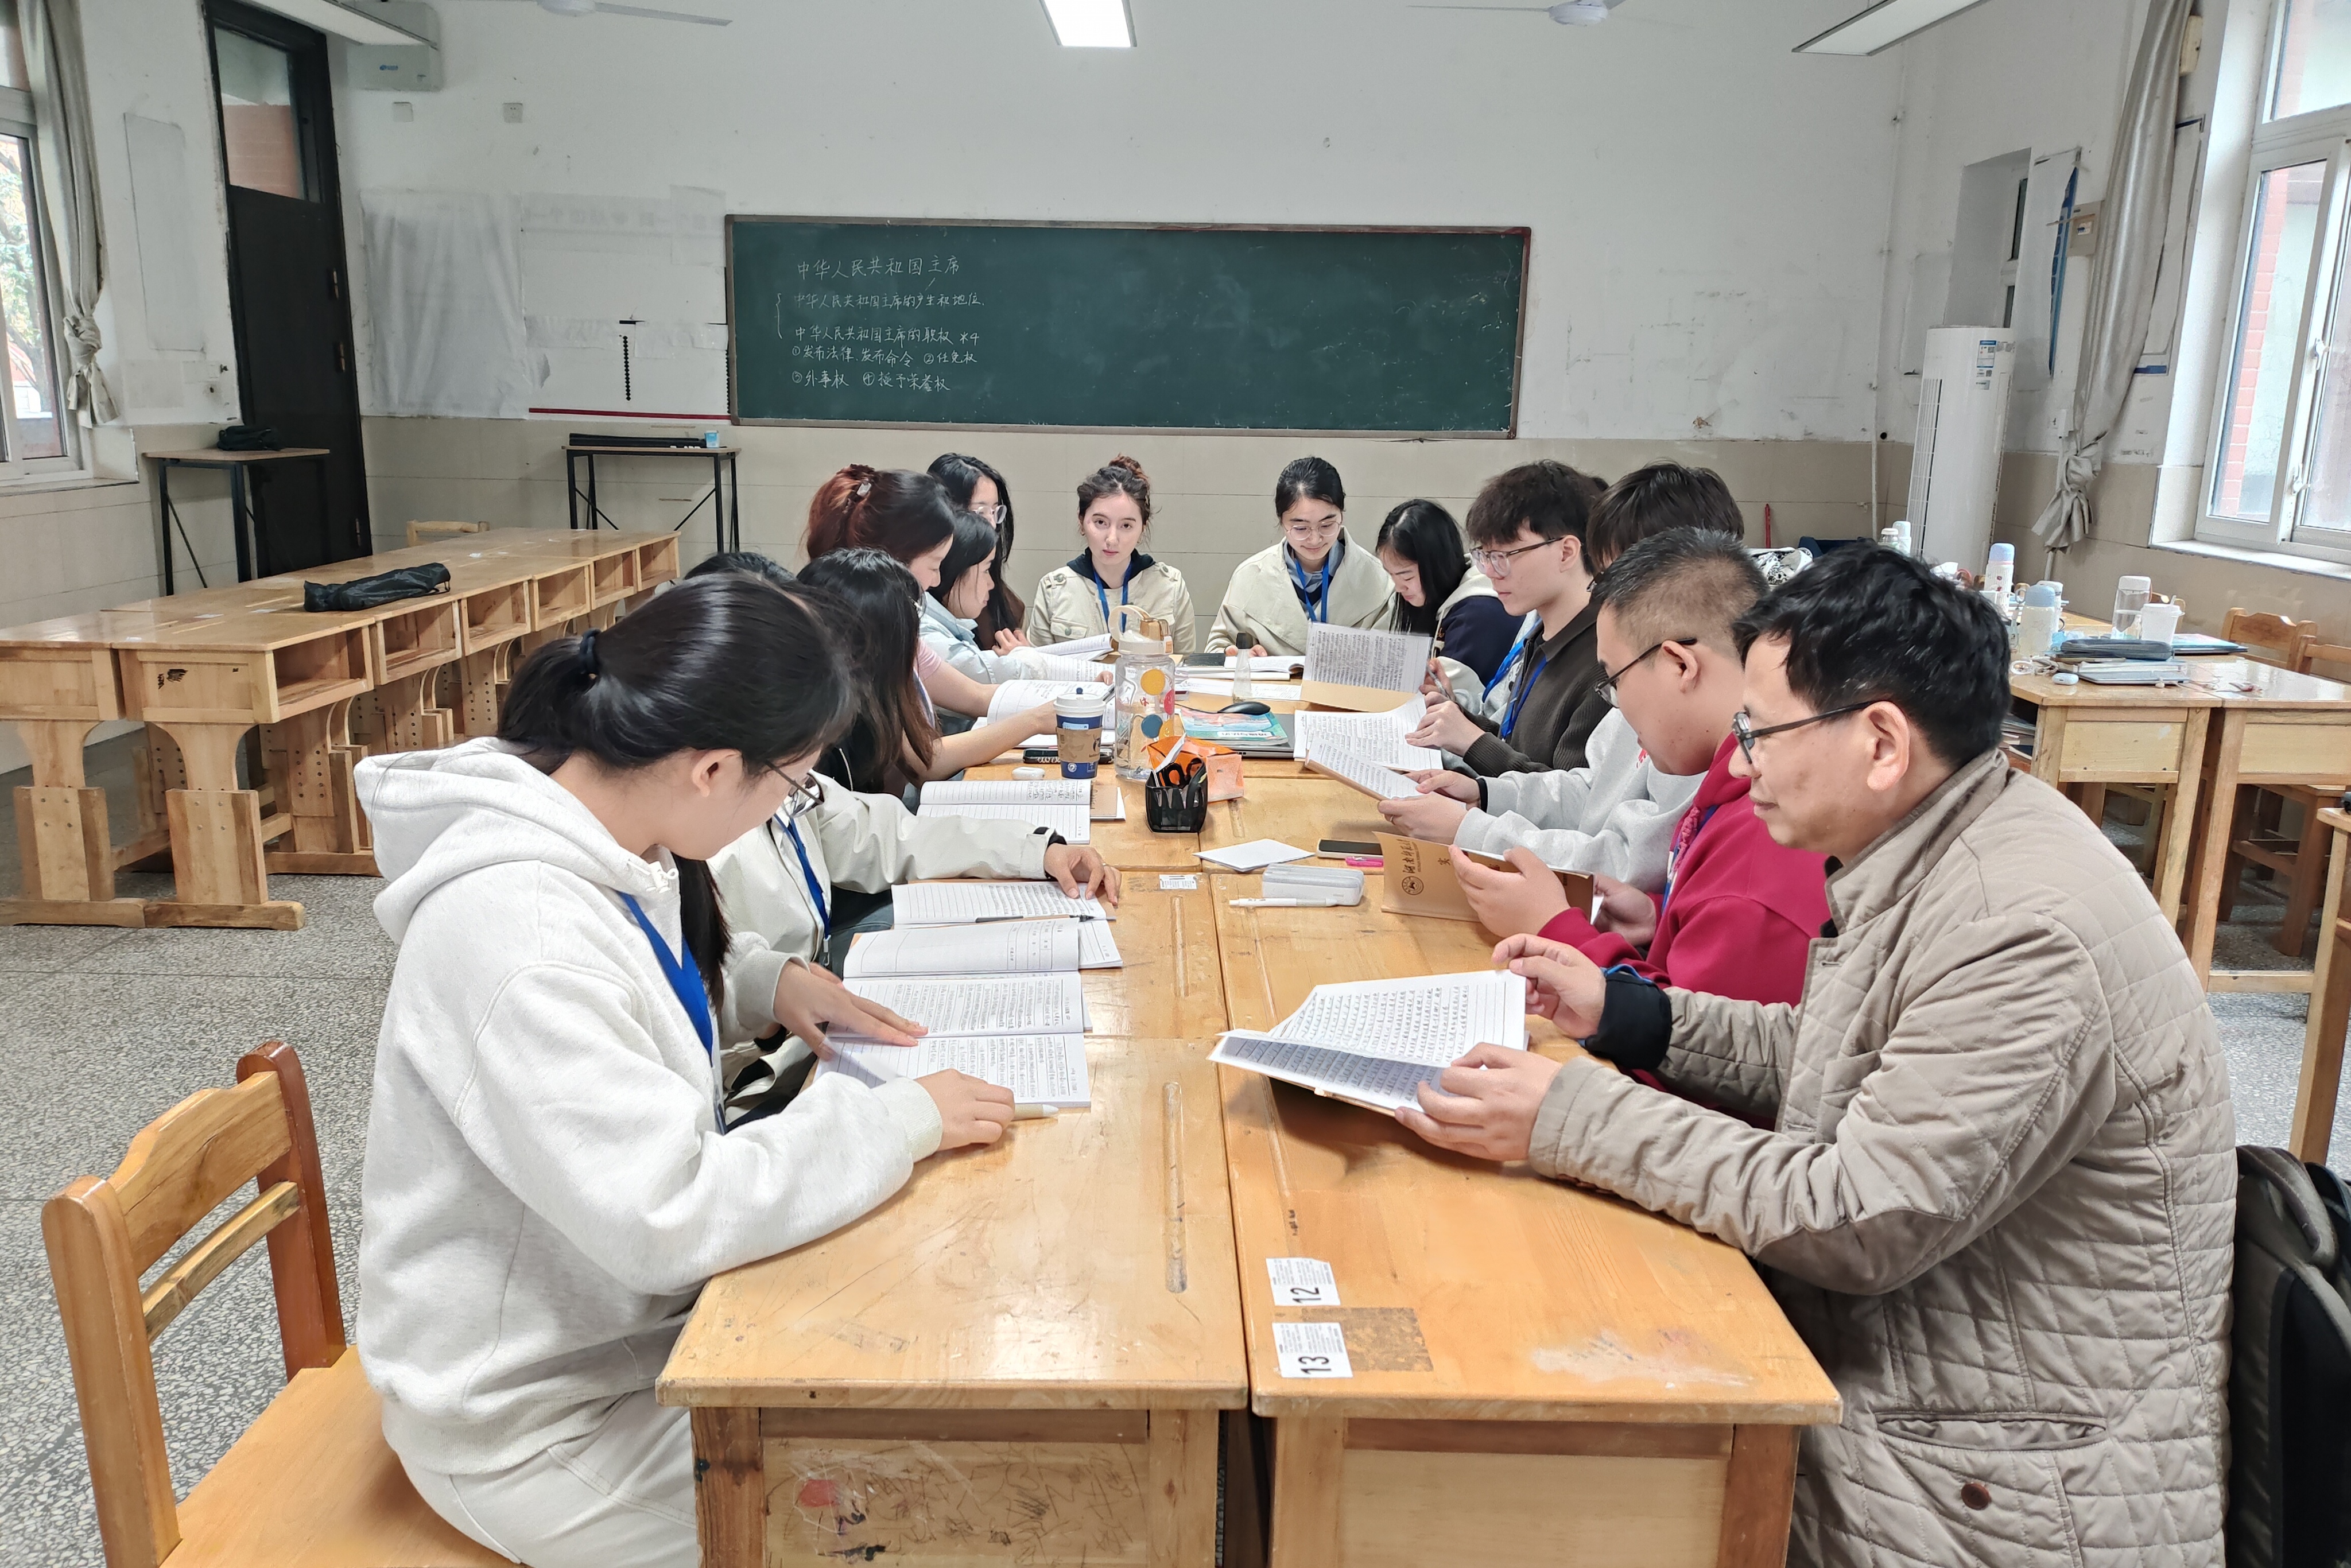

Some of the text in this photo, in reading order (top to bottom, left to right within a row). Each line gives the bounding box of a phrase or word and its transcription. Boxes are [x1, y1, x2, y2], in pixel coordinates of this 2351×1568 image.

[797, 254, 960, 281] 中华人民共和国主席
[794, 324, 953, 348] 中华人民共和国主席的职权
[1290, 1287, 1321, 1303] 12
[1298, 1356, 1332, 1375] 13
